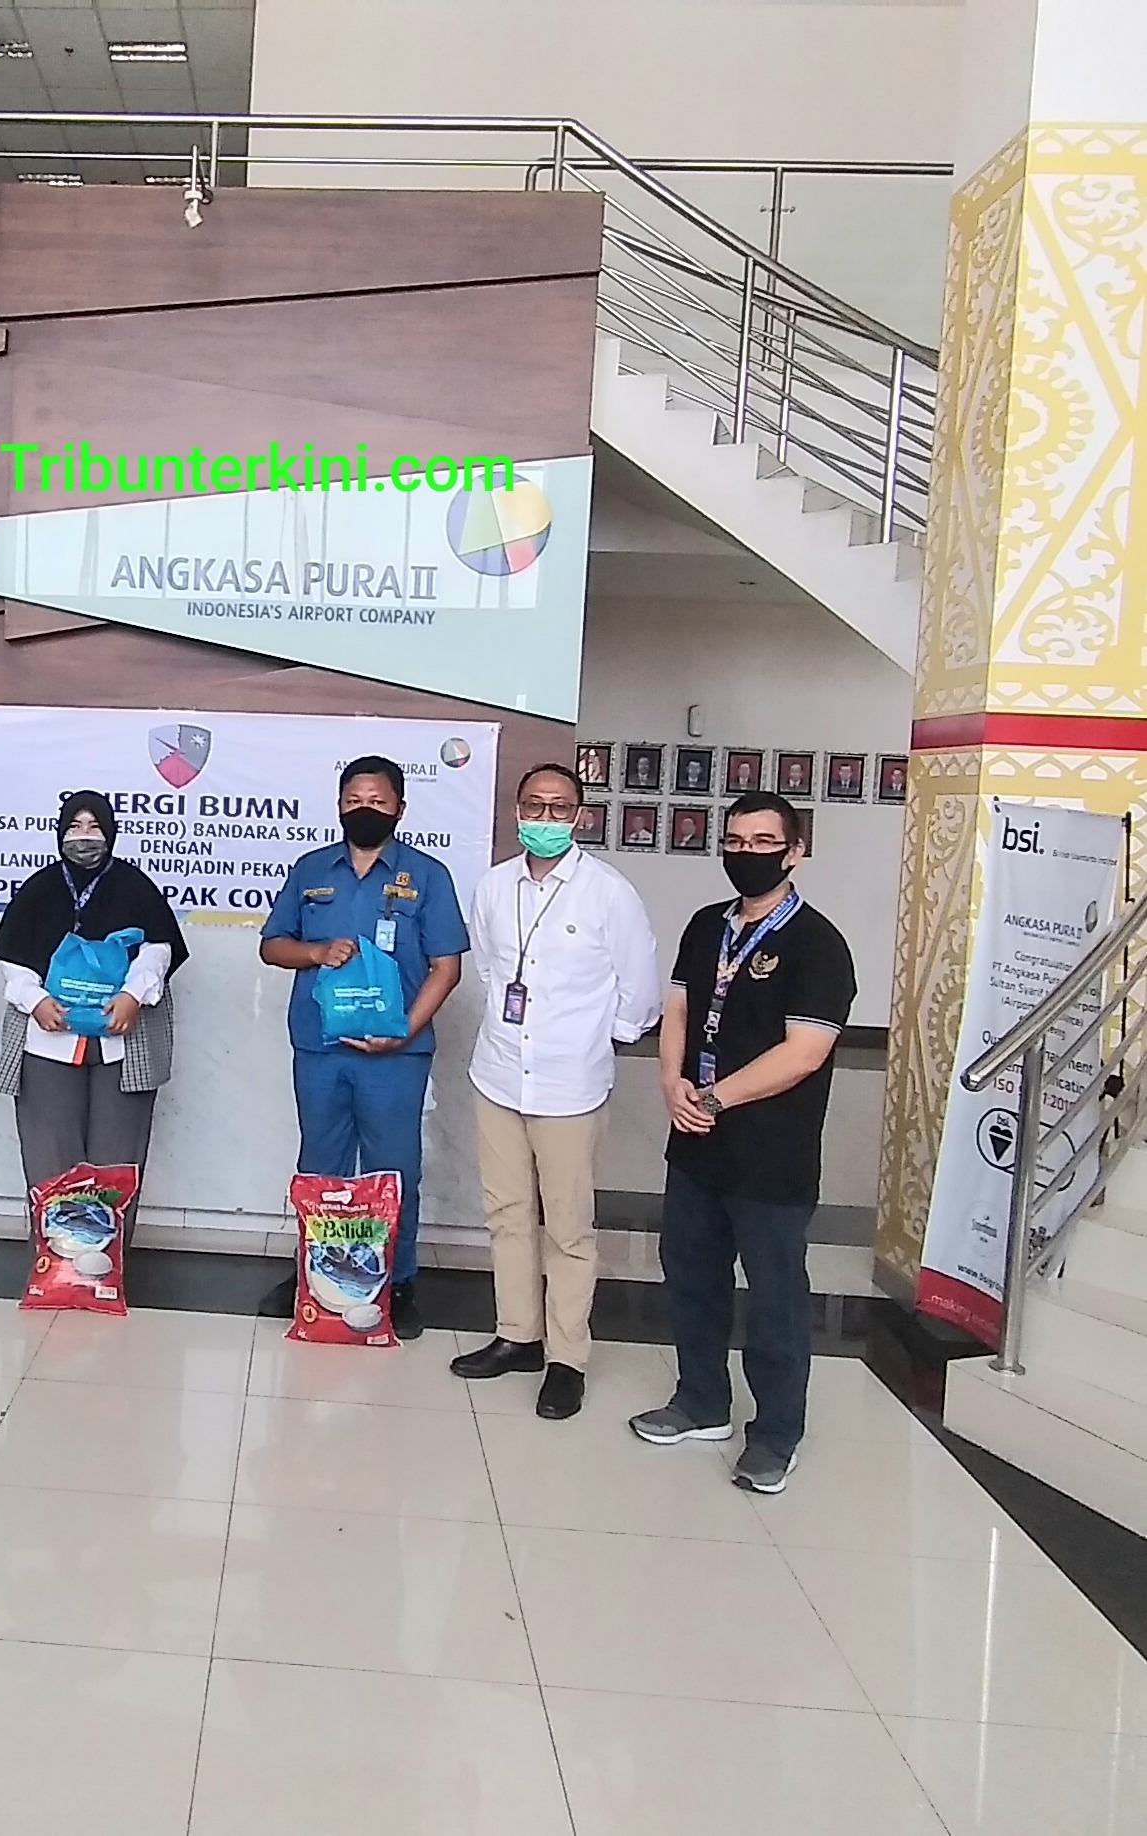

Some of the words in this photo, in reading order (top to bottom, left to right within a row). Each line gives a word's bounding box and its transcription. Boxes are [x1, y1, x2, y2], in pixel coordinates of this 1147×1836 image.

[110, 555, 291, 595] ANGKASA
[303, 562, 402, 599] PURA
[187, 602, 283, 620] INDONESIA'S
[288, 605, 354, 623] AIRPORT
[359, 608, 436, 626] COMPANY
[199, 796, 299, 820] BUMN
[25, 817, 59, 832] PUR
[193, 822, 280, 840] BANDARA
[286, 827, 318, 842] SSK
[324, 828, 335, 842] II
[1002, 817, 1045, 855] bsi.
[140, 840, 212, 856] DENGAN
[148, 859, 234, 877] NURJADIN
[1004, 914, 1051, 932] ANGKASA
[1052, 923, 1076, 938] PURA
[1004, 964, 1040, 981] Angkasa
[993, 1077, 1014, 1094] ISO
[323, 1220, 373, 1239] Belida
